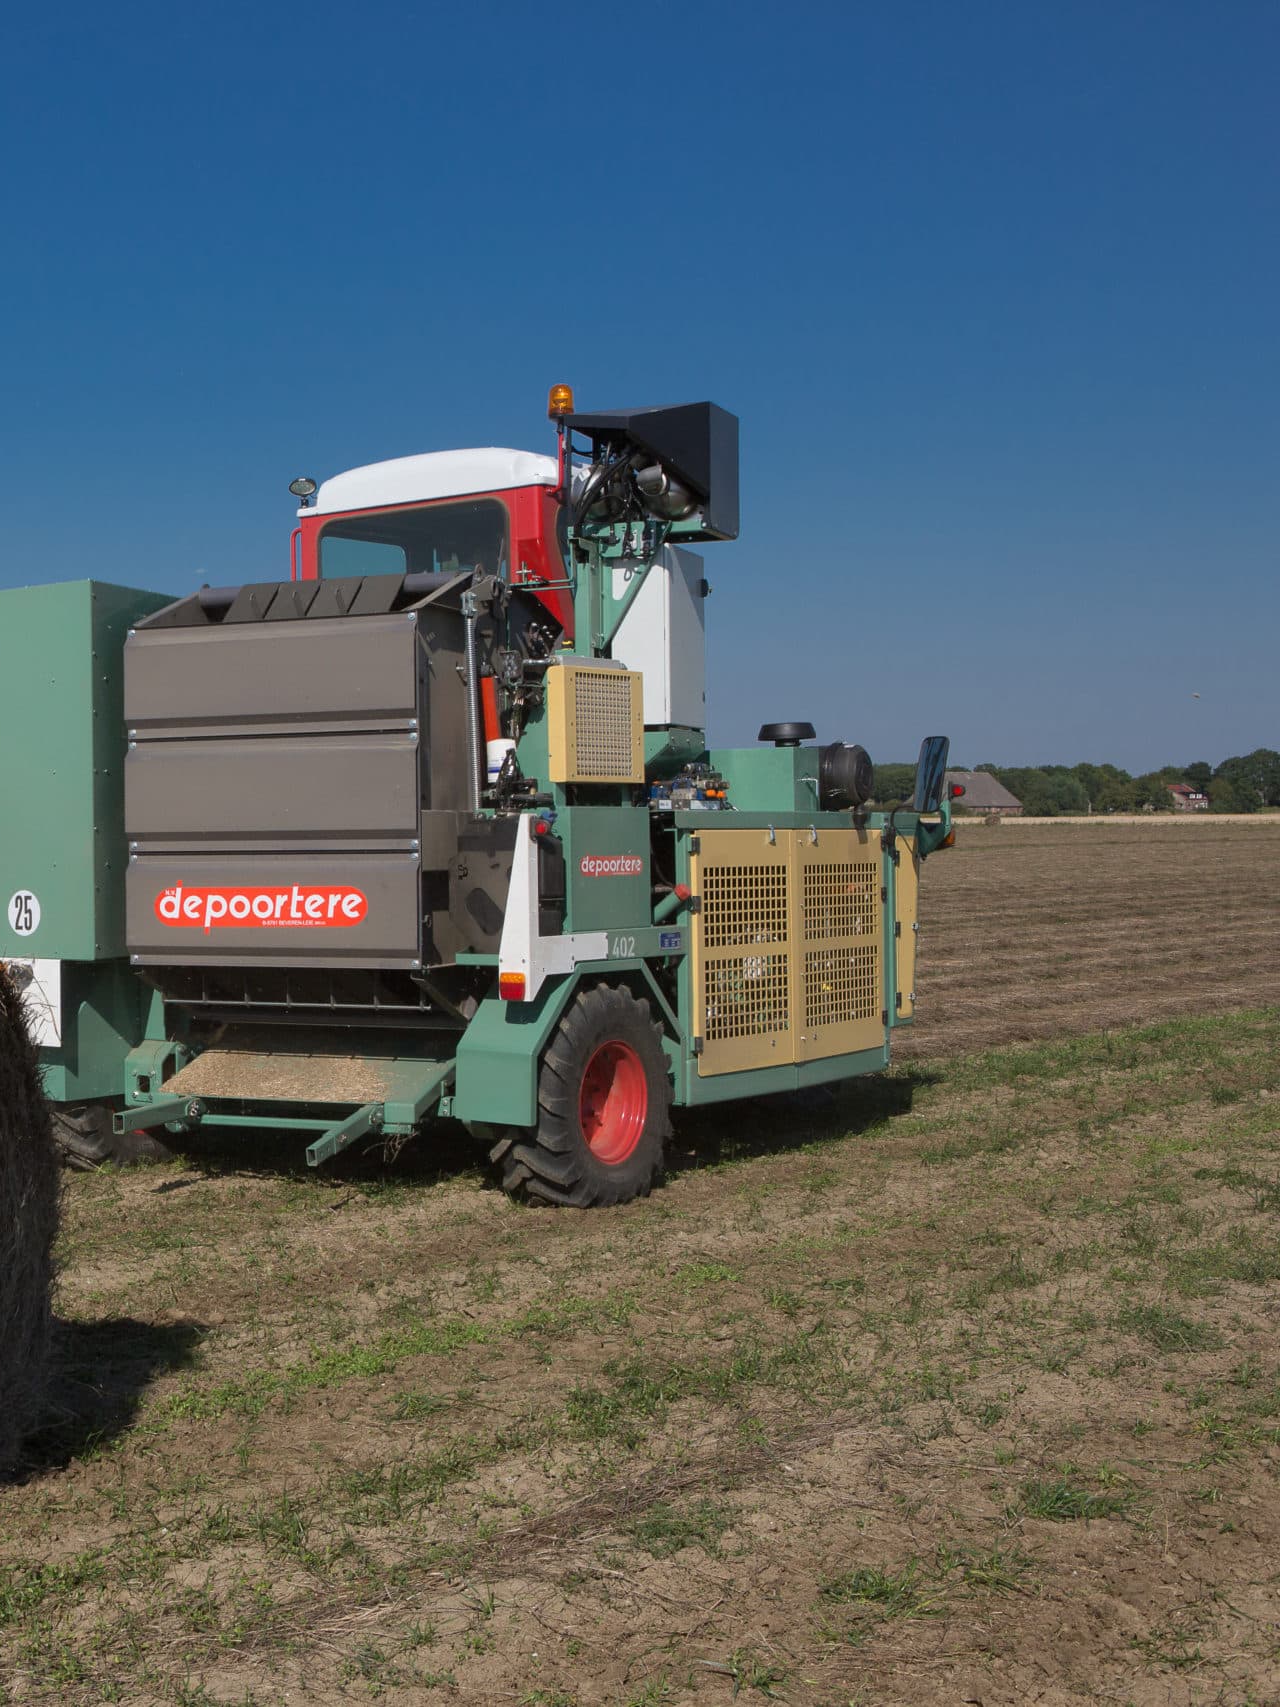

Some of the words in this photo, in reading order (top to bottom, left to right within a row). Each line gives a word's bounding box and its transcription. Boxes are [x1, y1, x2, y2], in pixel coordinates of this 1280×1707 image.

[581, 855, 641, 876] depoortere
[15, 895, 32, 930] 25
[159, 886, 362, 928] depoortere
[612, 936, 635, 958] 402
